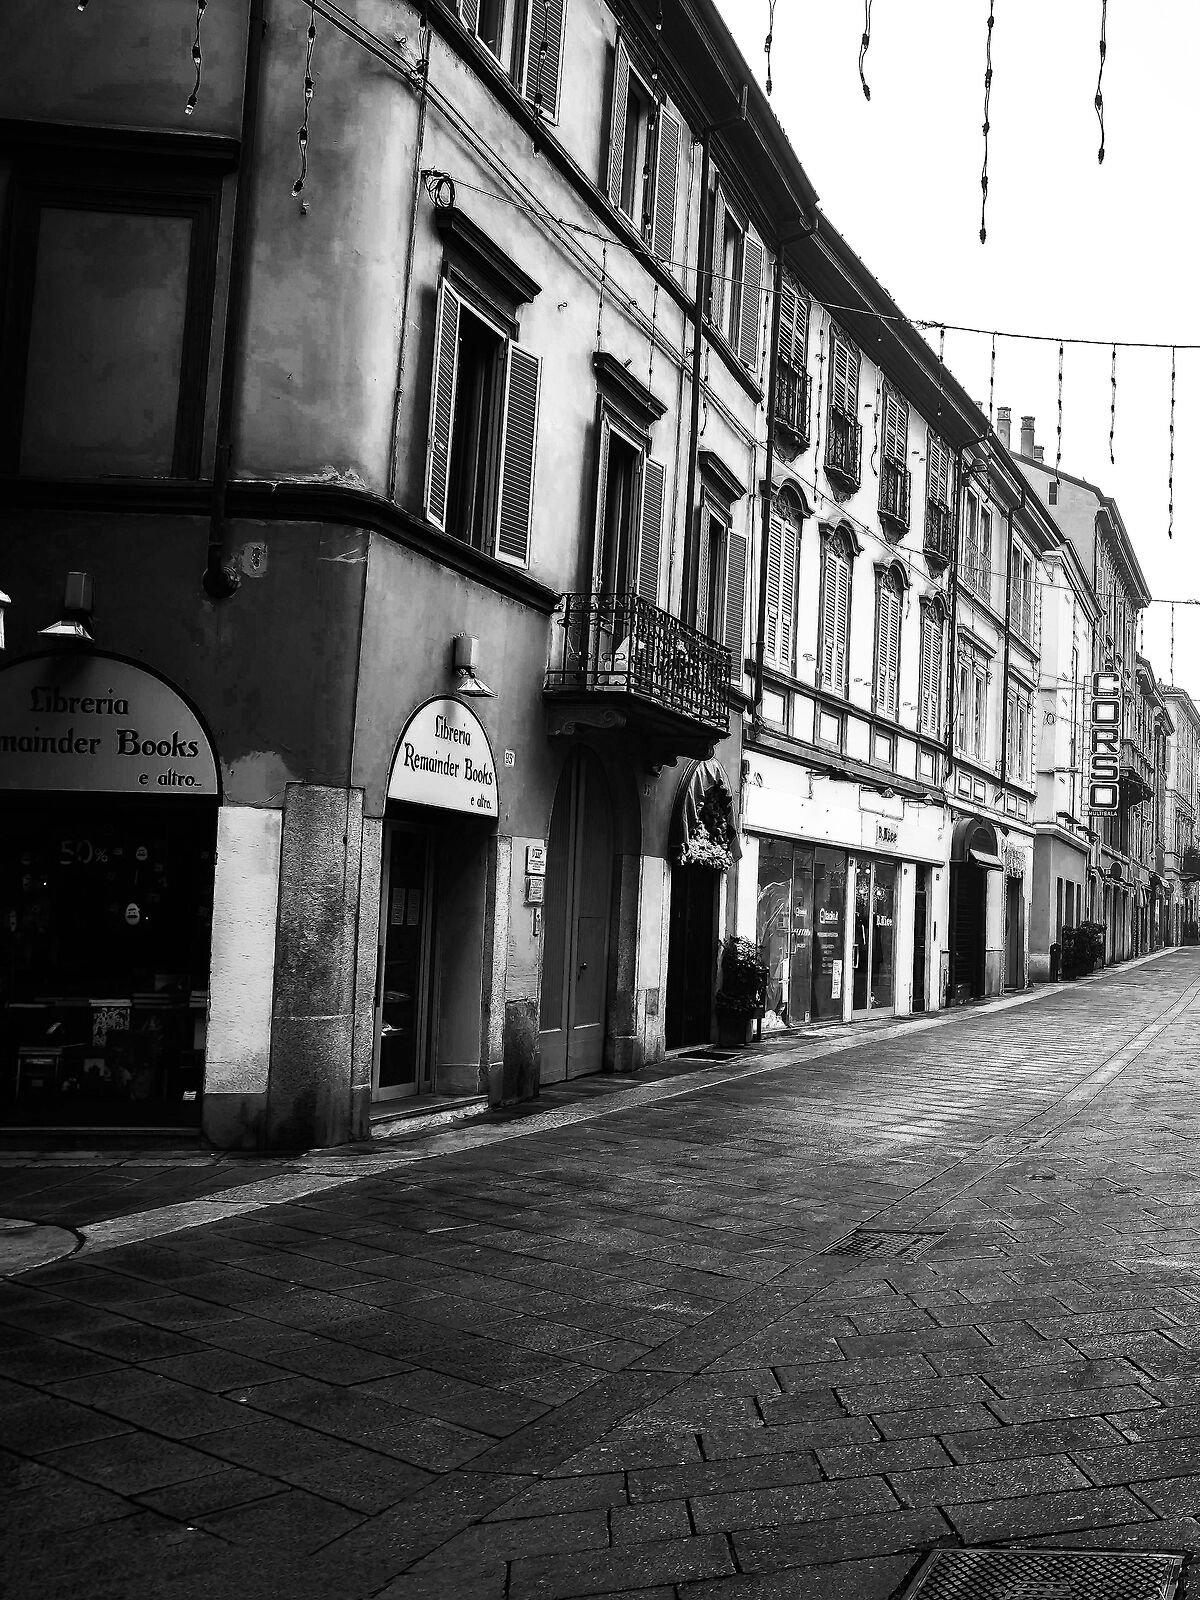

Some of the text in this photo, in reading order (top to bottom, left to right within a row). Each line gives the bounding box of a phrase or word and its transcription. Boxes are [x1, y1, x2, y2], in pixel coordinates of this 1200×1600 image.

[30, 687, 130, 715] Libreria
[116, 729, 200, 757] Books
[435, 714, 471, 746] Libreria
[1090, 672, 1120, 809] CORSO
[404, 742, 493, 785] Remainder Books
[138, 773, 149, 785] e
[470, 796, 475, 806] e
